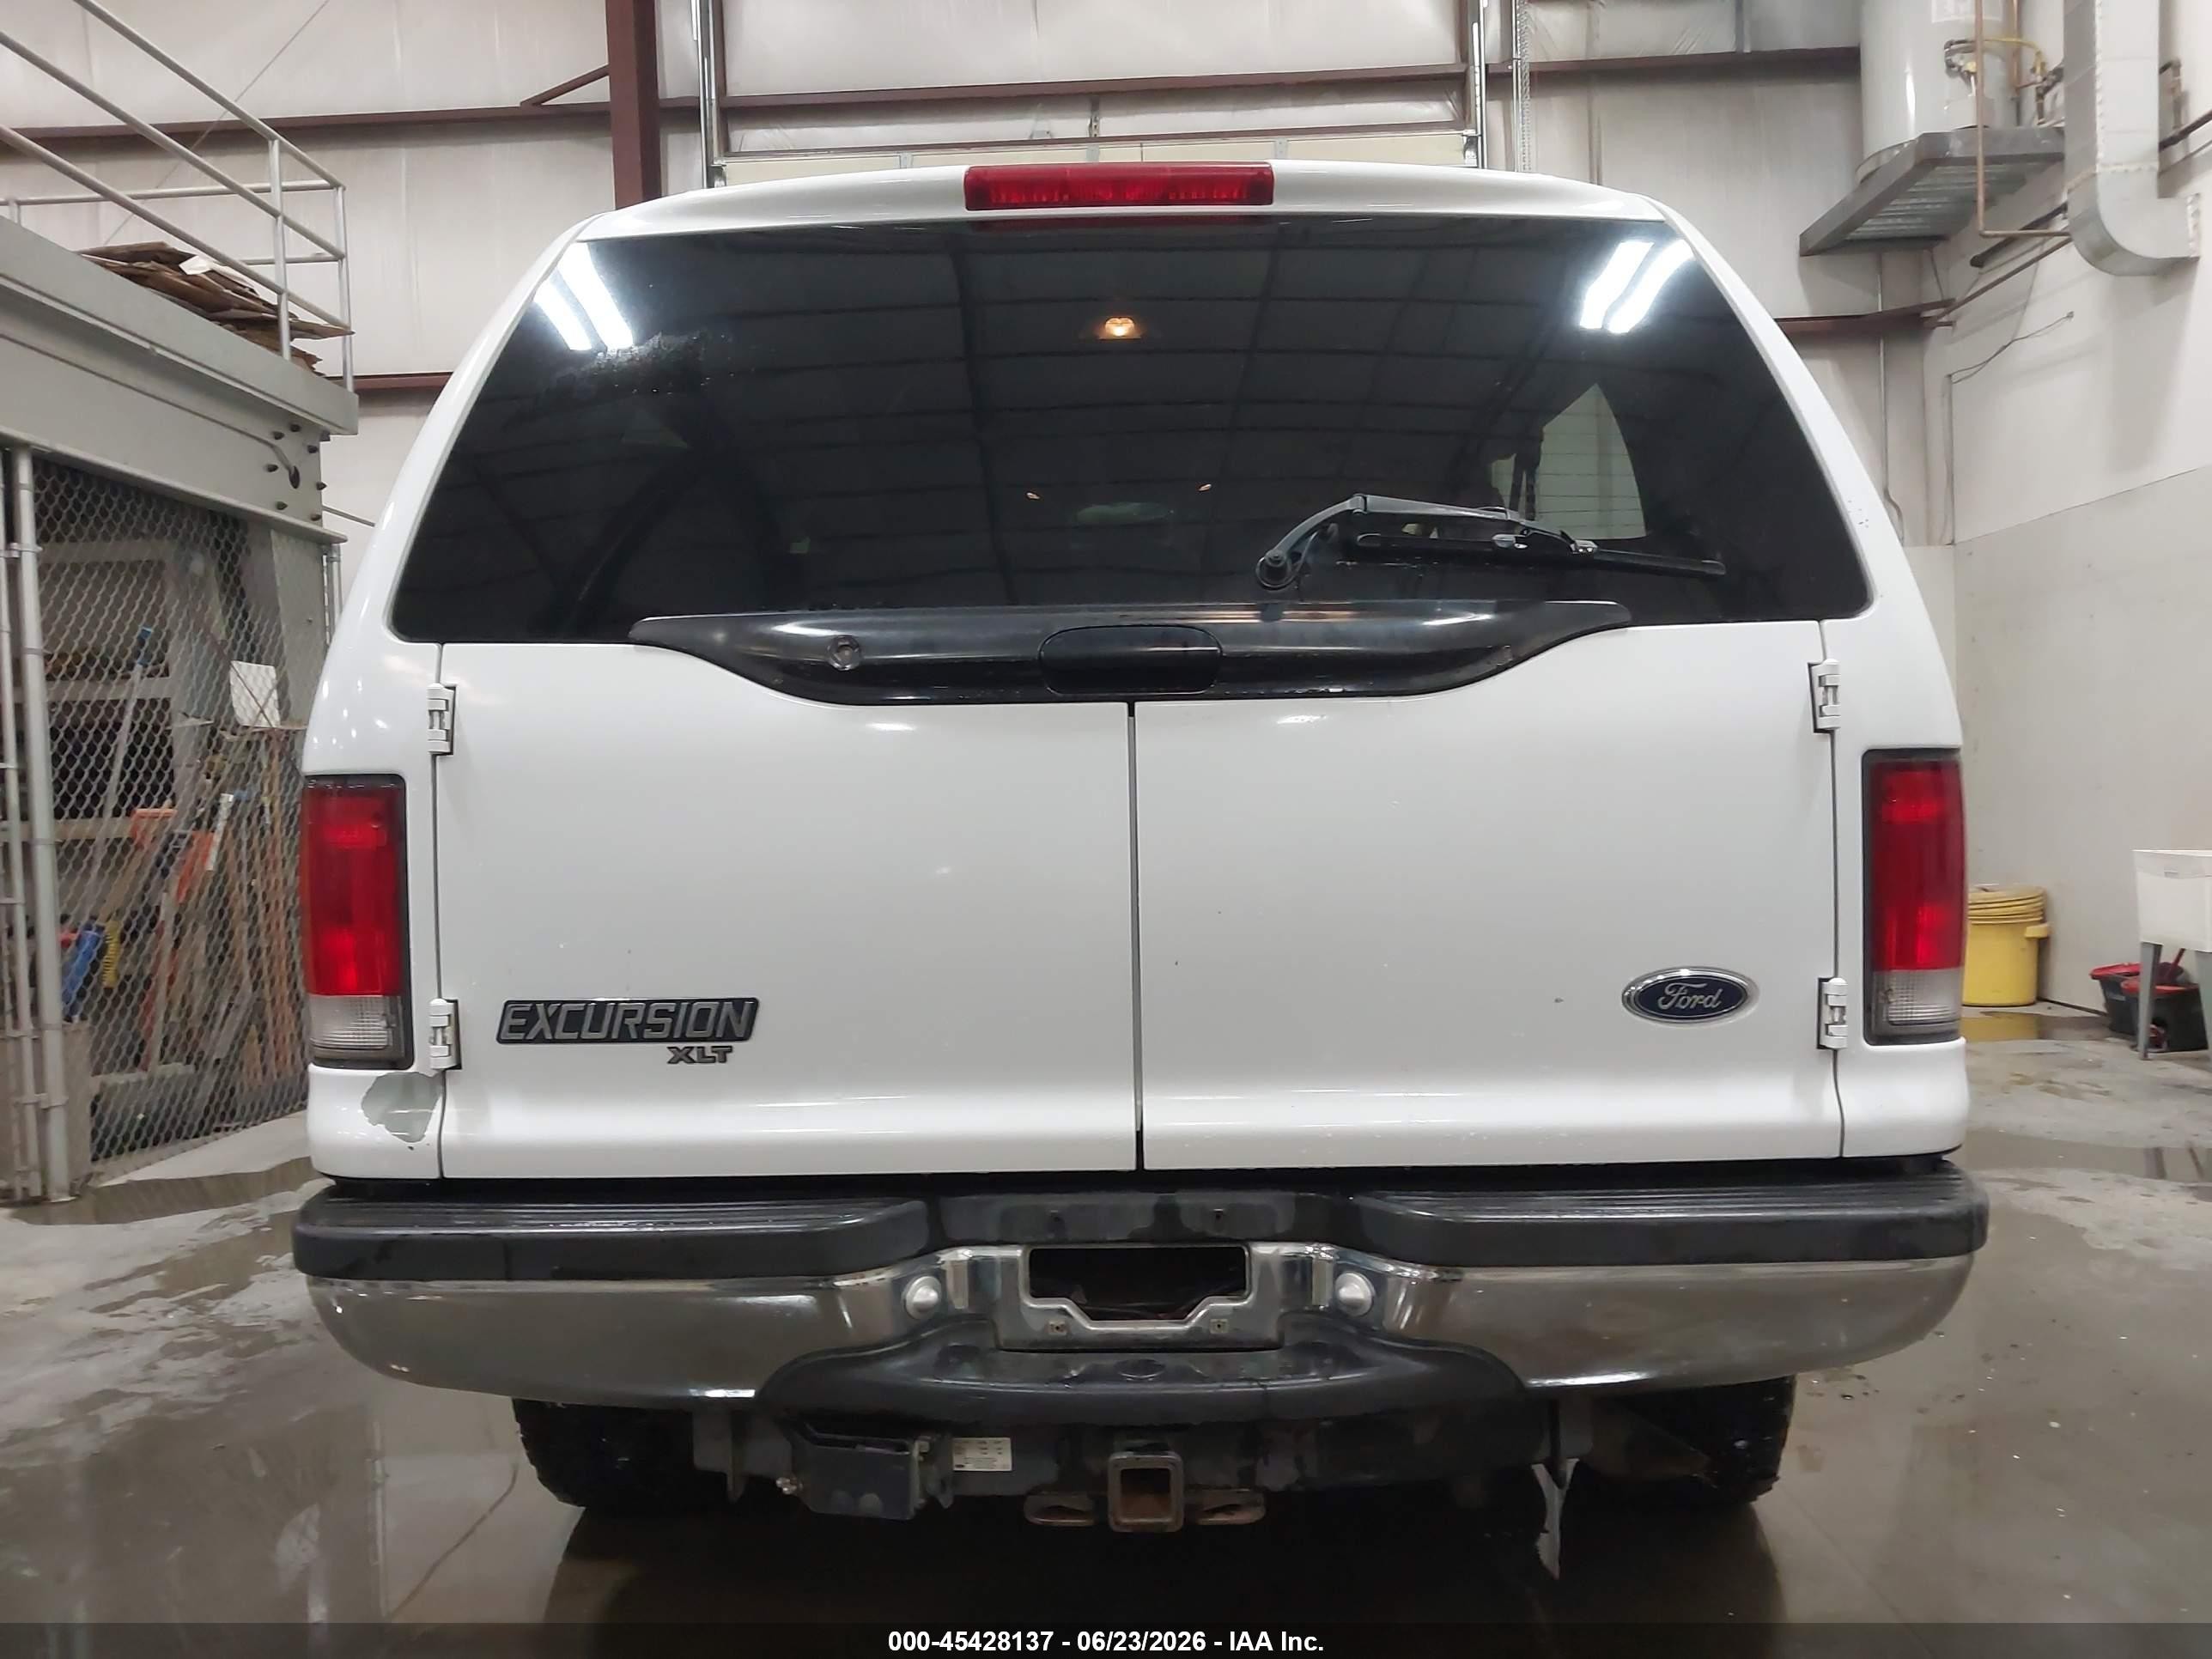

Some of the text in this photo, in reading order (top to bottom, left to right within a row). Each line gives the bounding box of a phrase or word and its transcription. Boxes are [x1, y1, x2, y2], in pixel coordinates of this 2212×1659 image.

[1657, 982, 1723, 1010] Ford
[500, 1001, 755, 1040] EXCURSION
[667, 1046, 732, 1064] XLT
